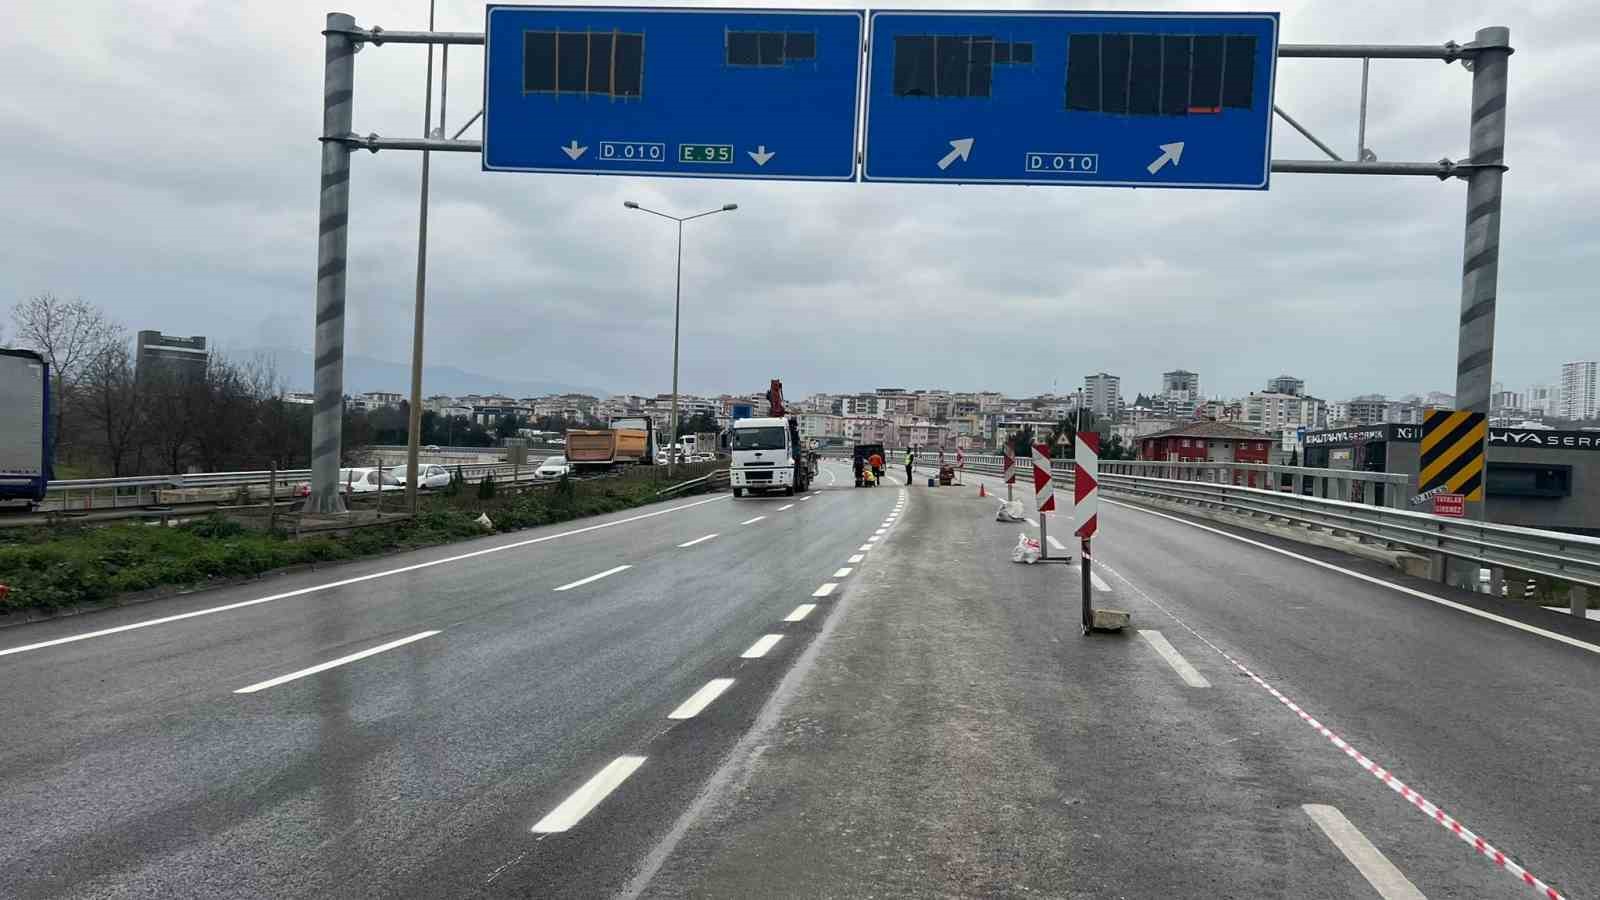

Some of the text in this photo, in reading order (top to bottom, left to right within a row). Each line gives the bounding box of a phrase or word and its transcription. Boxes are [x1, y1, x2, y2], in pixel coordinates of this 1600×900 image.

[604, 144, 660, 159] D.010
[684, 146, 729, 161] E.95
[1031, 156, 1092, 170] D.010
